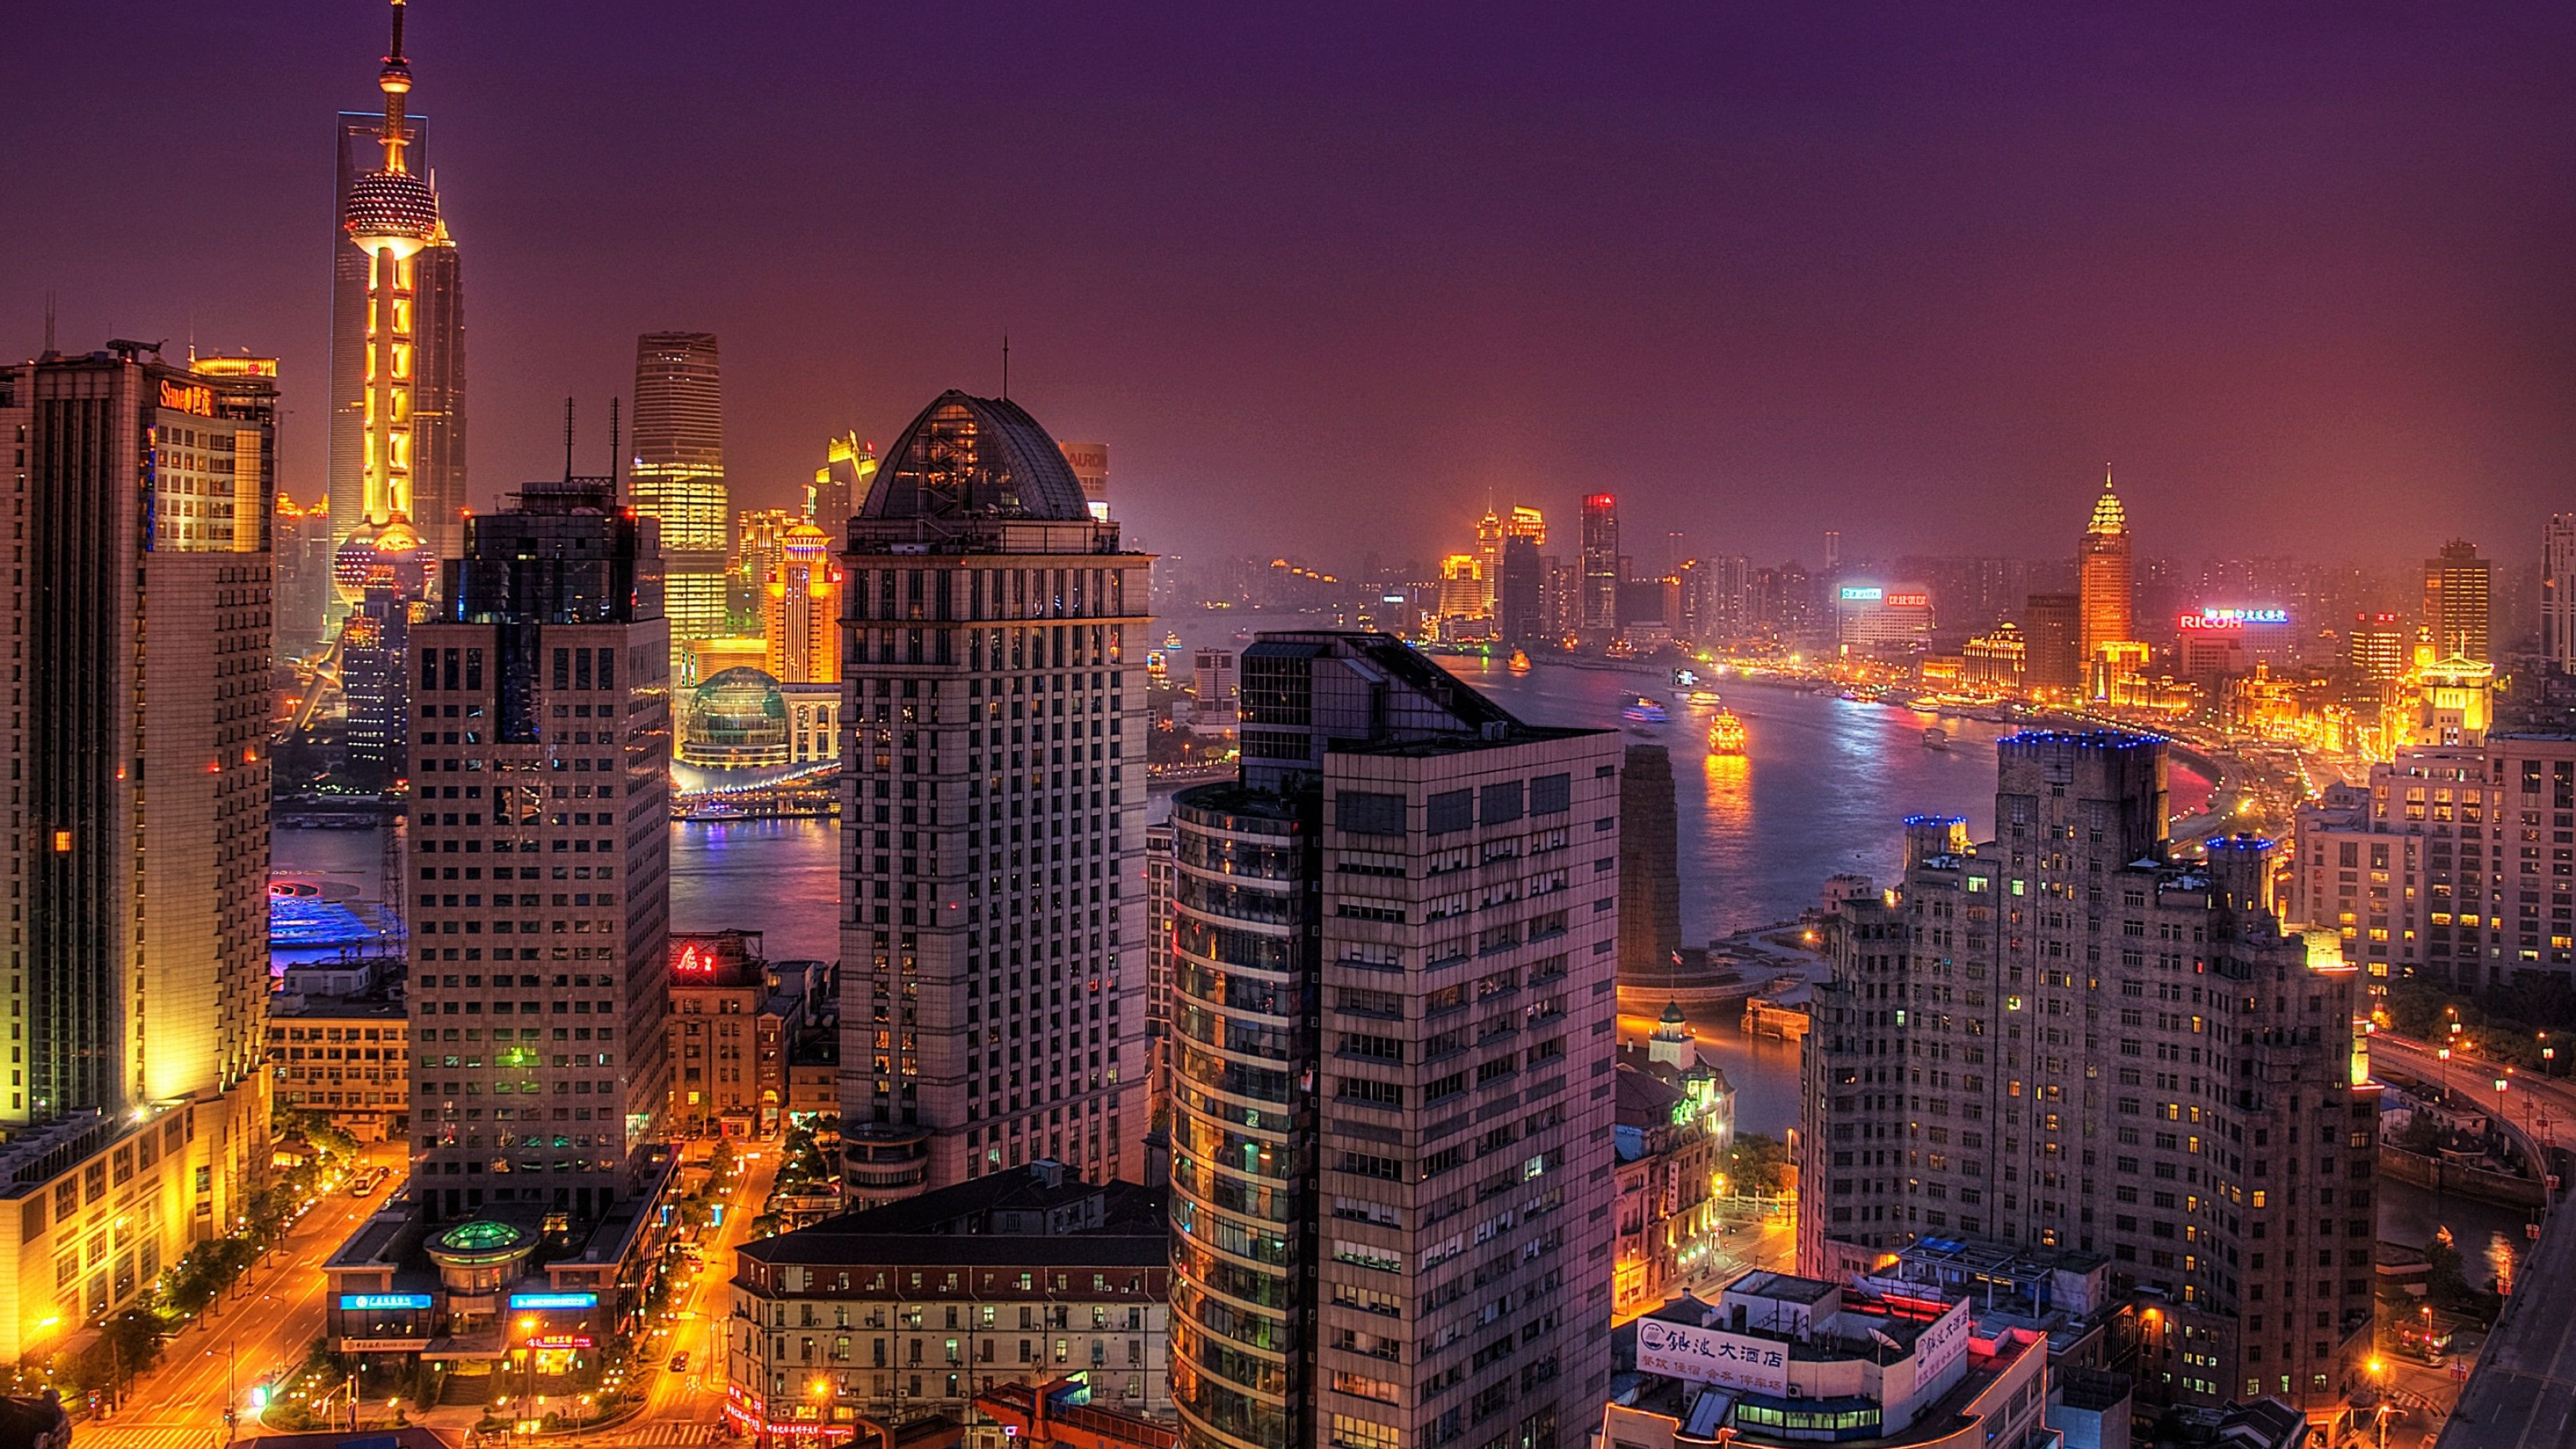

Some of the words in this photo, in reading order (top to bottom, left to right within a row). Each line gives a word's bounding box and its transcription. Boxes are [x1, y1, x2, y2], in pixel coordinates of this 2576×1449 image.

[193, 386, 212, 416] 世茂
[2180, 615, 2243, 628] RICOH
[1666, 1330, 1783, 1368] 银波大酒店
[1642, 1355, 1669, 1370] 餐饮
[1705, 1369, 1734, 1382] 会务
[1740, 1374, 1783, 1391] 停车场
